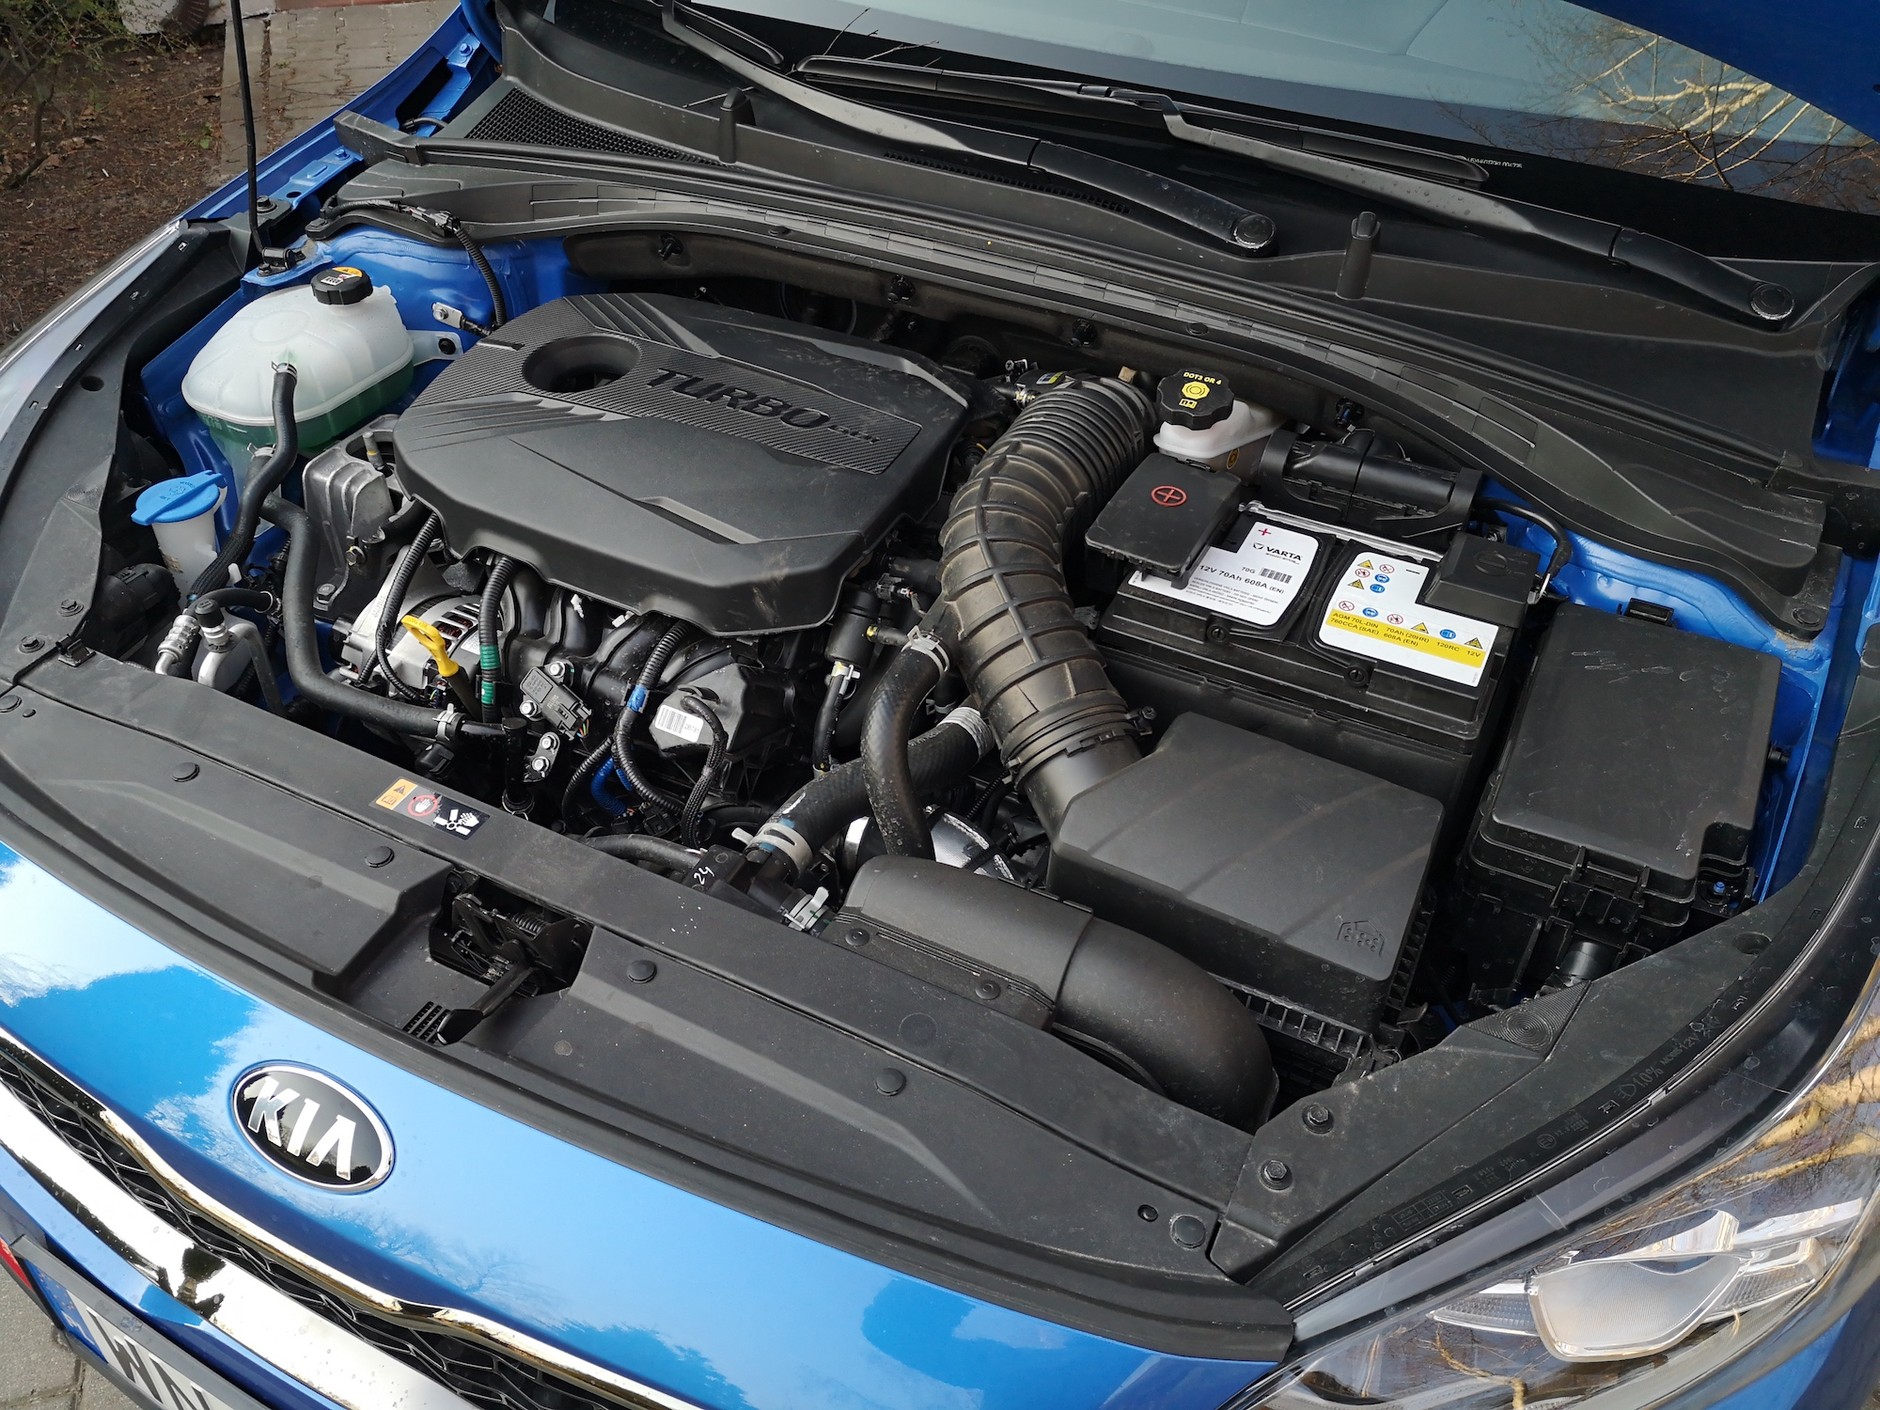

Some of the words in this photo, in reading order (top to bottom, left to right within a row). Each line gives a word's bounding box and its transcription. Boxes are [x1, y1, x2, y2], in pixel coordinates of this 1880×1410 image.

[1183, 371, 1204, 382] DOT3
[1203, 376, 1216, 384] OR
[647, 367, 831, 429] TURBO
[1266, 546, 1302, 561] VARTA
[1200, 565, 1217, 573] 12V
[1219, 570, 1242, 581] 70Ah
[1244, 578, 1268, 589] 608A
[1269, 585, 1284, 594] (EN)
[1333, 612, 1350, 621] AGM
[1386, 627, 1404, 636] 70Ah
[1436, 641, 1460, 652] 120RC
[1467, 650, 1481, 658] 12V
[1403, 638, 1419, 647] (EN)
[693, 866, 715, 885] 24
